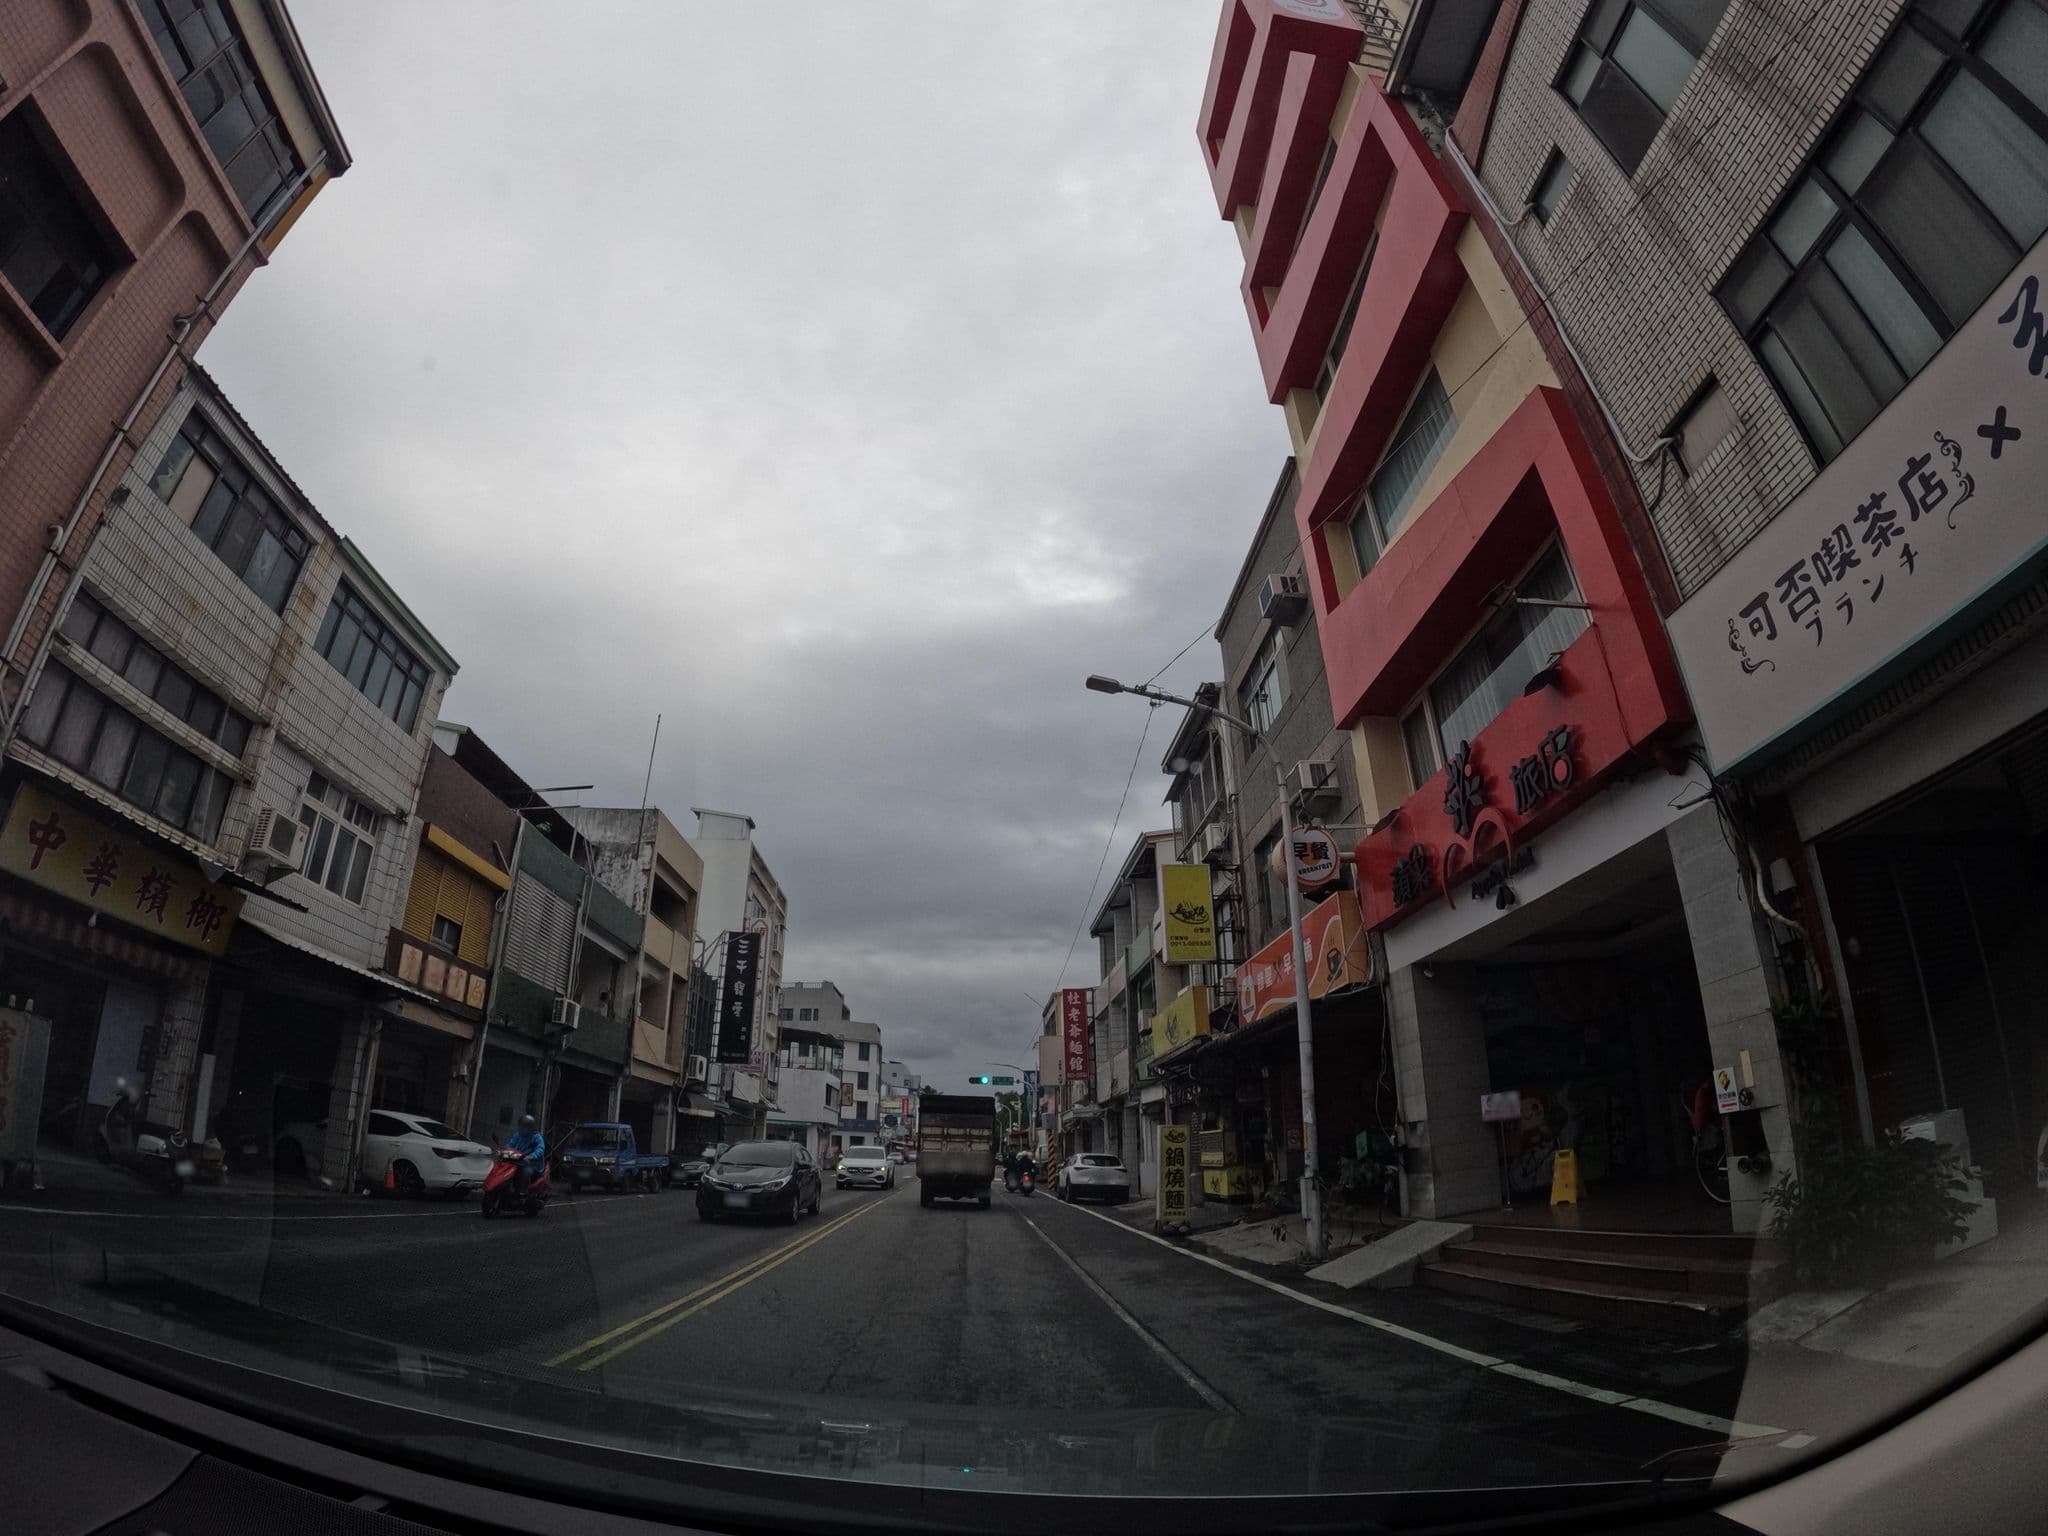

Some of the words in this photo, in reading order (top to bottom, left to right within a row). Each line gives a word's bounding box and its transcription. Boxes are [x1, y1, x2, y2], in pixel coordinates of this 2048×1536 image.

[1740, 452, 1948, 640] 可否喫茶店
[1806, 543, 1919, 647] ブランチ
[29, 811, 227, 942] 中華檳榔
[1293, 842, 1330, 861] 早餐
[1165, 1147, 1185, 1209] 鍋燒麵
